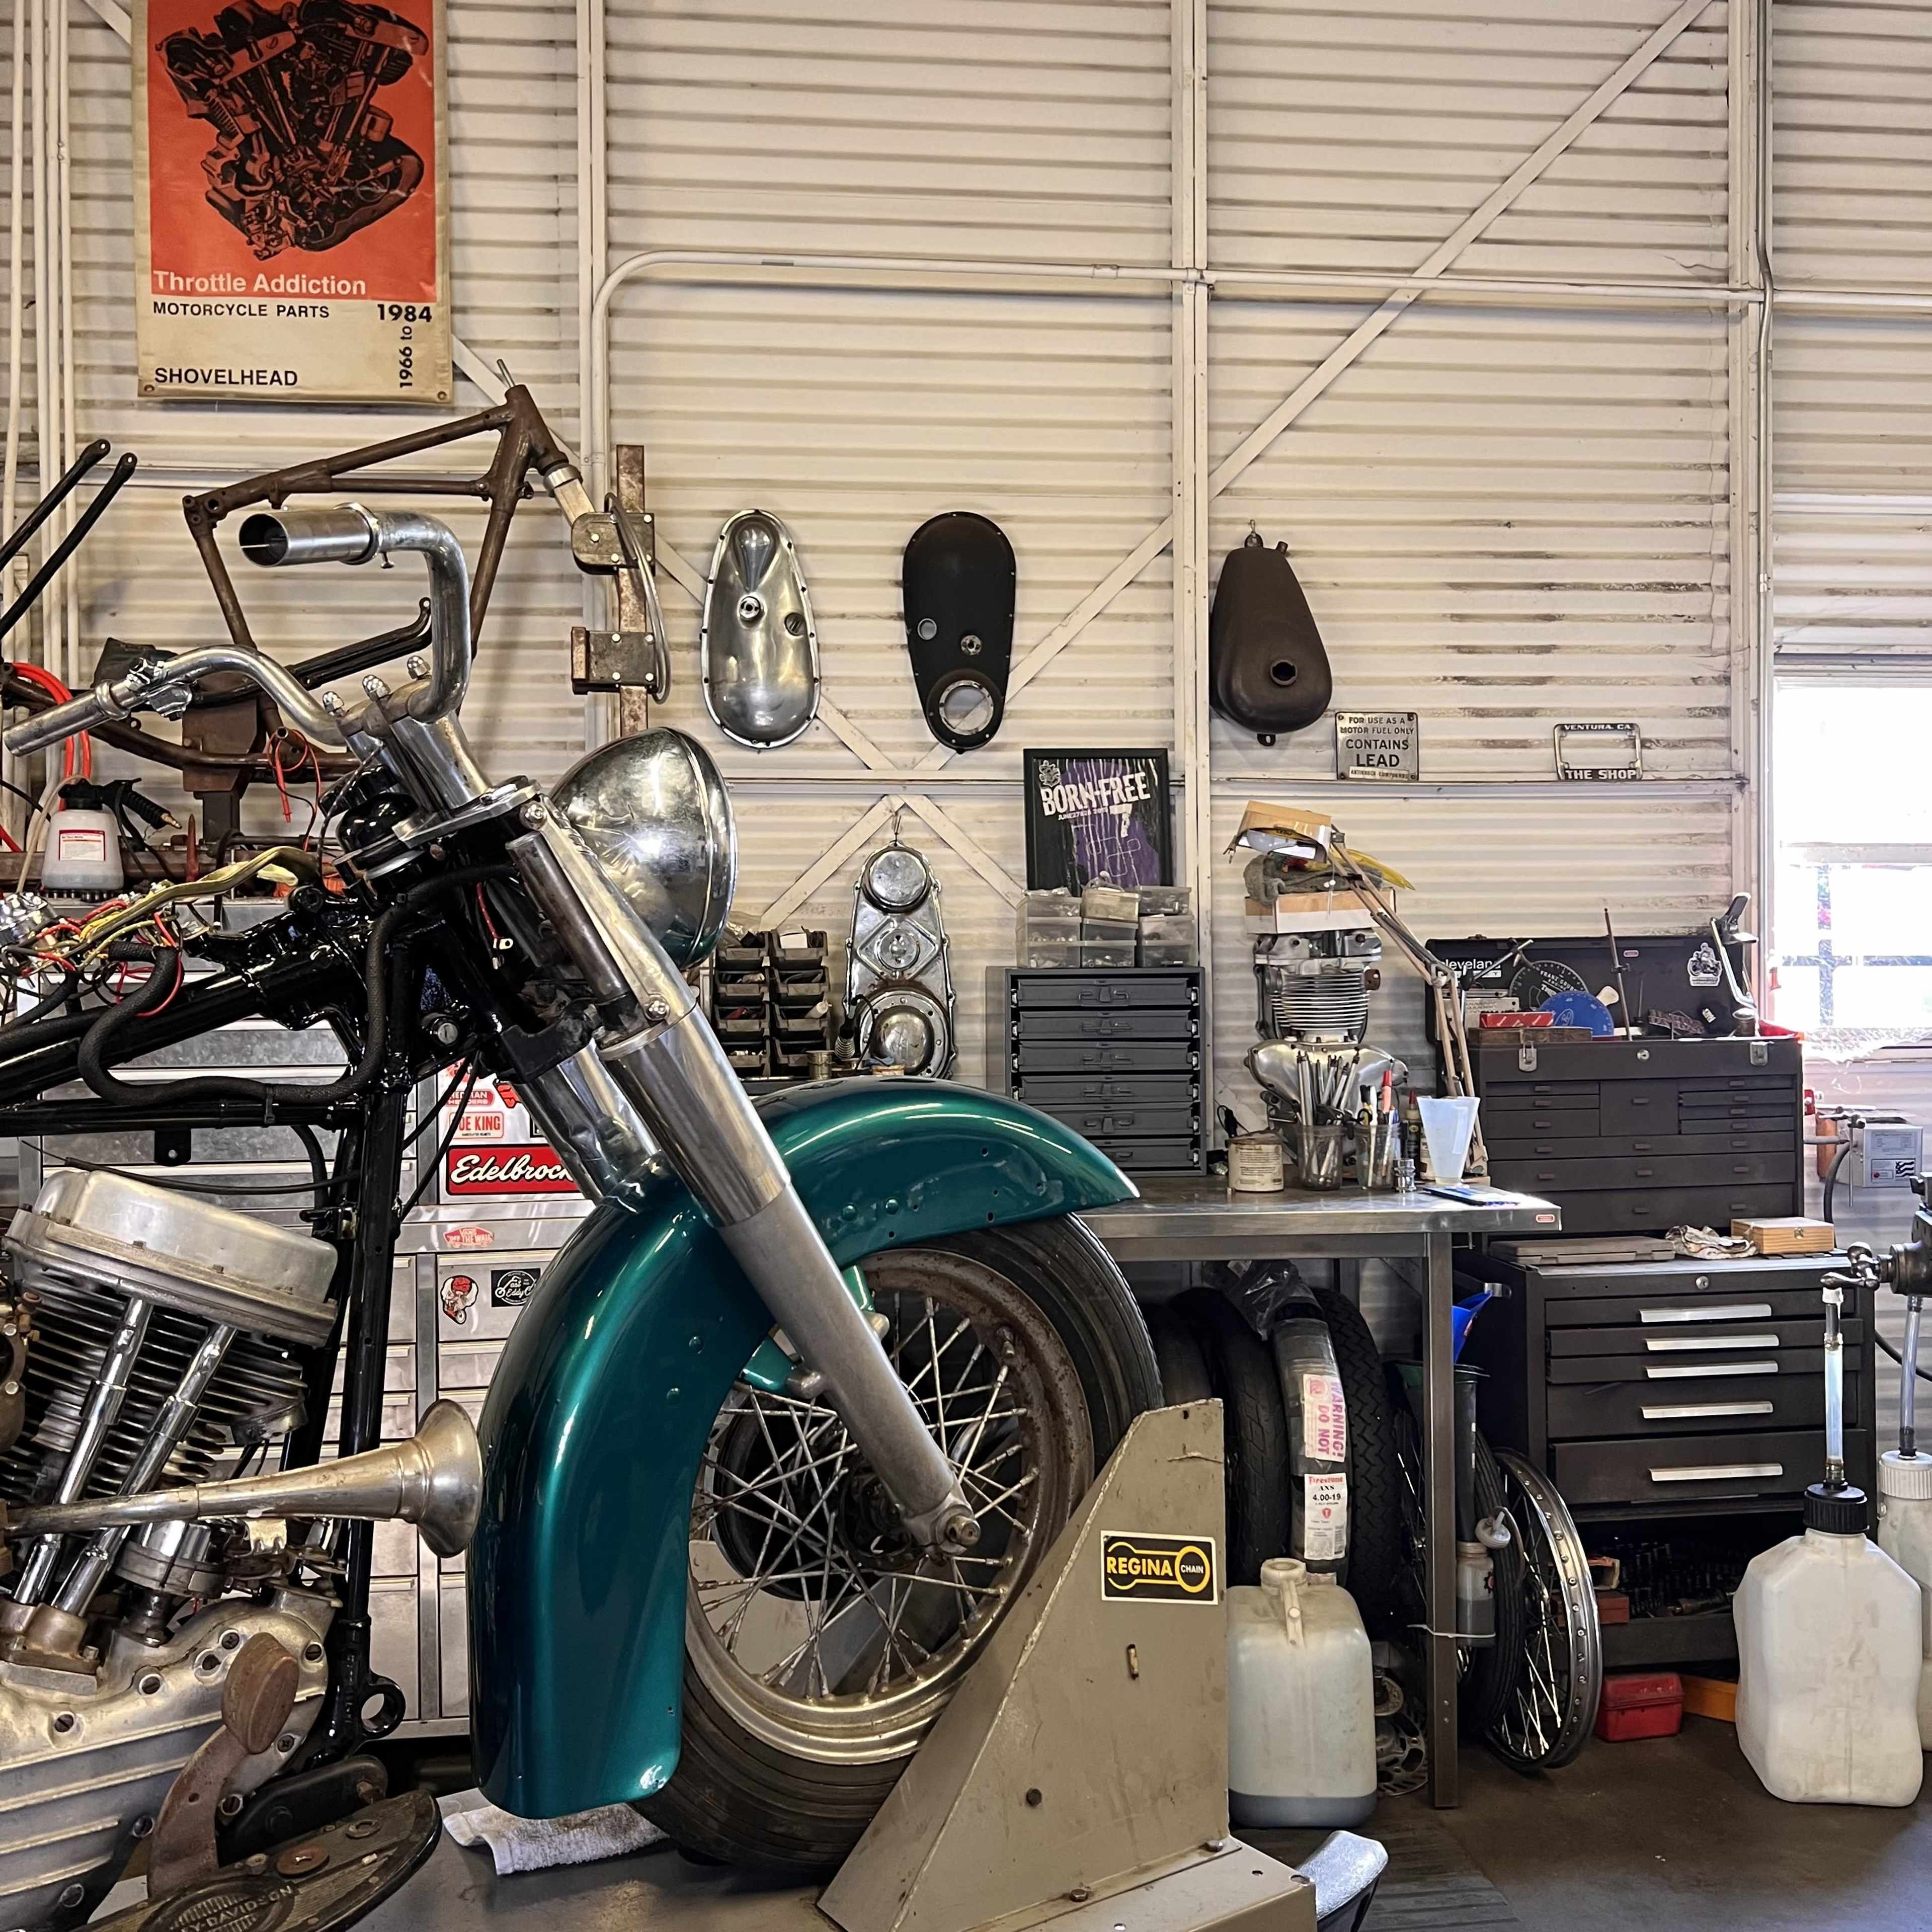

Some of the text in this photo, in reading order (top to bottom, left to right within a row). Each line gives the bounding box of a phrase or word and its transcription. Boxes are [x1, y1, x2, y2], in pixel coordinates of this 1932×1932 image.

[153, 270, 366, 295] Throttle Addiction
[153, 301, 330, 318] MOTORCYCLE PARTS
[377, 304, 432, 323] 1984
[399, 326, 413, 388] 1966 to
[154, 368, 298, 386] SHOVELHEAD
[1346, 739, 1409, 750] CONTAINS
[1356, 754, 1400, 767] LEAD
[1565, 770, 1636, 780] THE SHOP
[1441, 958, 1500, 970] levelan
[474, 1115, 501, 1131] KING
[1331, 1382, 1344, 1458] WARNING!
[1318, 1405, 1330, 1454] DO NOT
[1308, 1476, 1343, 1485] Firestone
[1312, 1493, 1341, 1501] 4.00-19
[1107, 1556, 1204, 1577] REGINA CHAIN
